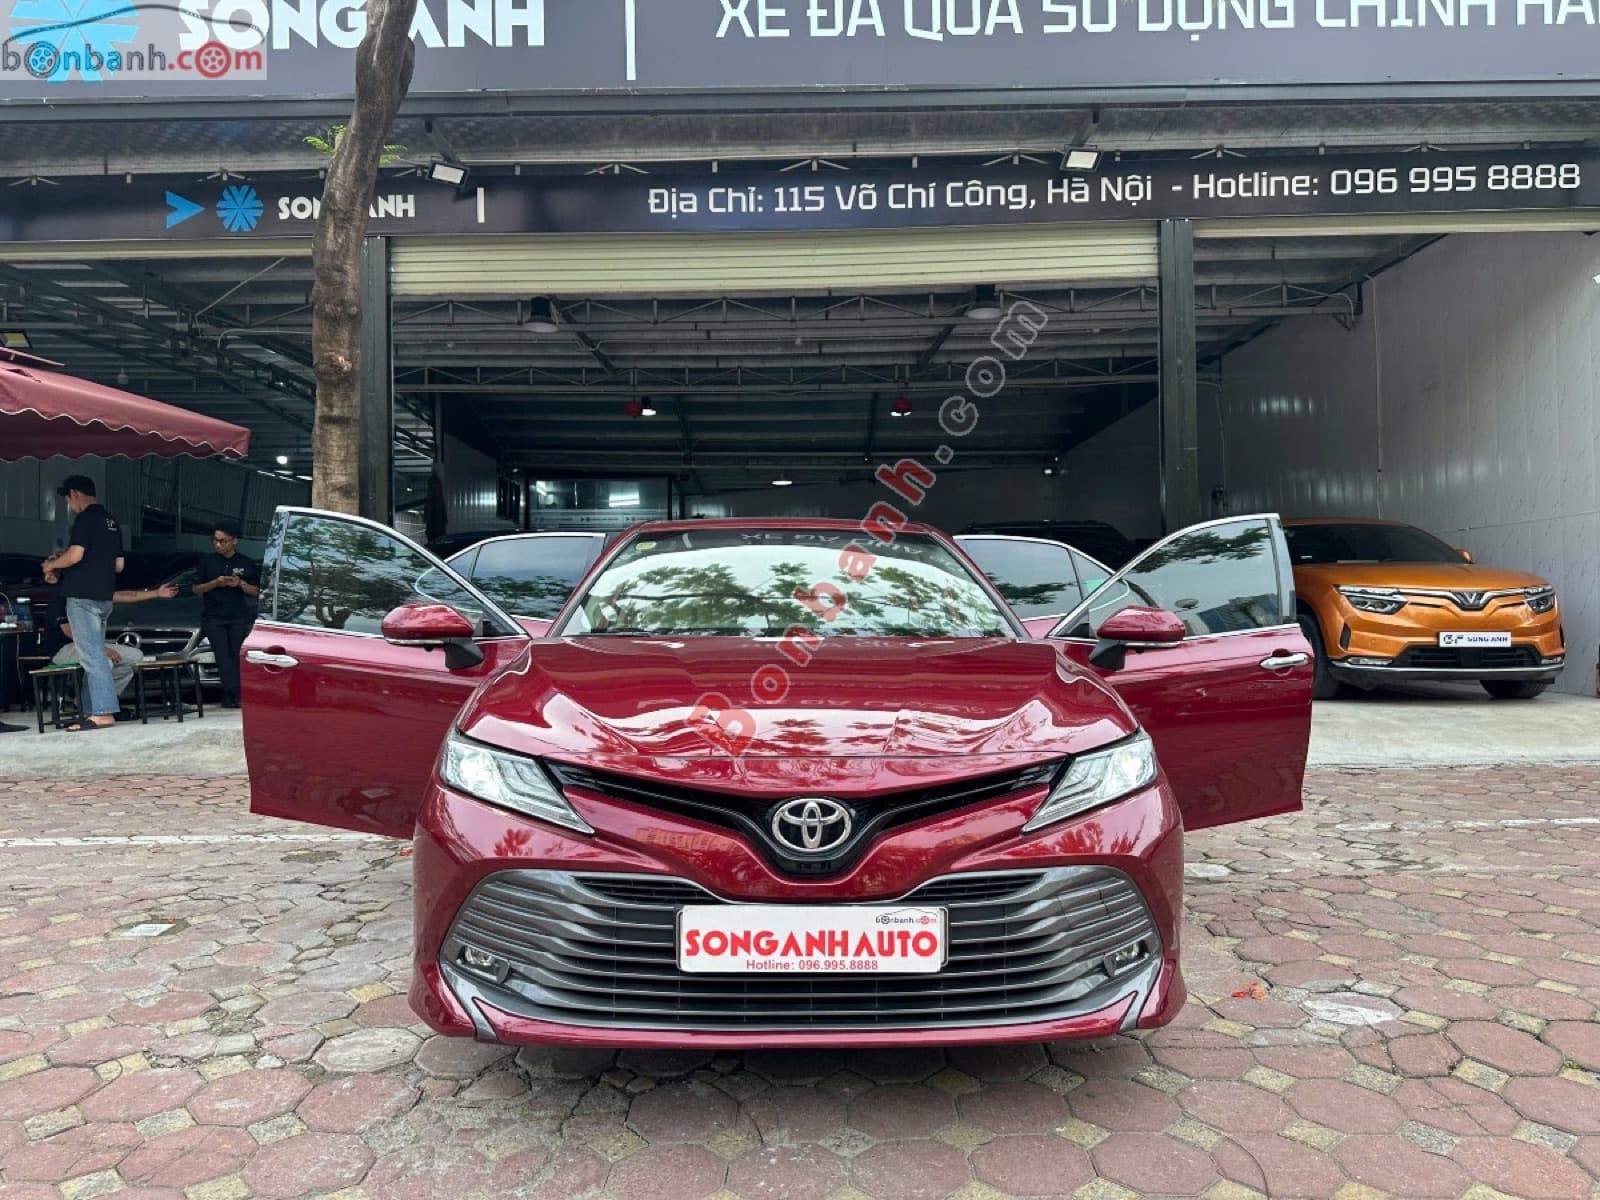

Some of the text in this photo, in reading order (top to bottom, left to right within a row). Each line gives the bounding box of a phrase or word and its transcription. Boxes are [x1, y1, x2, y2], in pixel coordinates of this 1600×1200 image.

[715, 0, 791, 38] XE
[904, 0, 1024, 42] QUA
[648, 187, 698, 219] Địa
[708, 186, 764, 214] Chỉ:
[774, 186, 825, 212] 115
[835, 183, 878, 210] Võ
[888, 182, 937, 209] Chí
[946, 180, 1037, 210] Công,
[1101, 174, 1152, 206] Nội
[1193, 171, 1319, 199] Hotline:
[1330, 168, 1398, 195] 096
[1409, 166, 1477, 194] 995
[1487, 164, 1581, 191] 8888
[746, 959, 879, 971] Hotline: 096.995.8888
